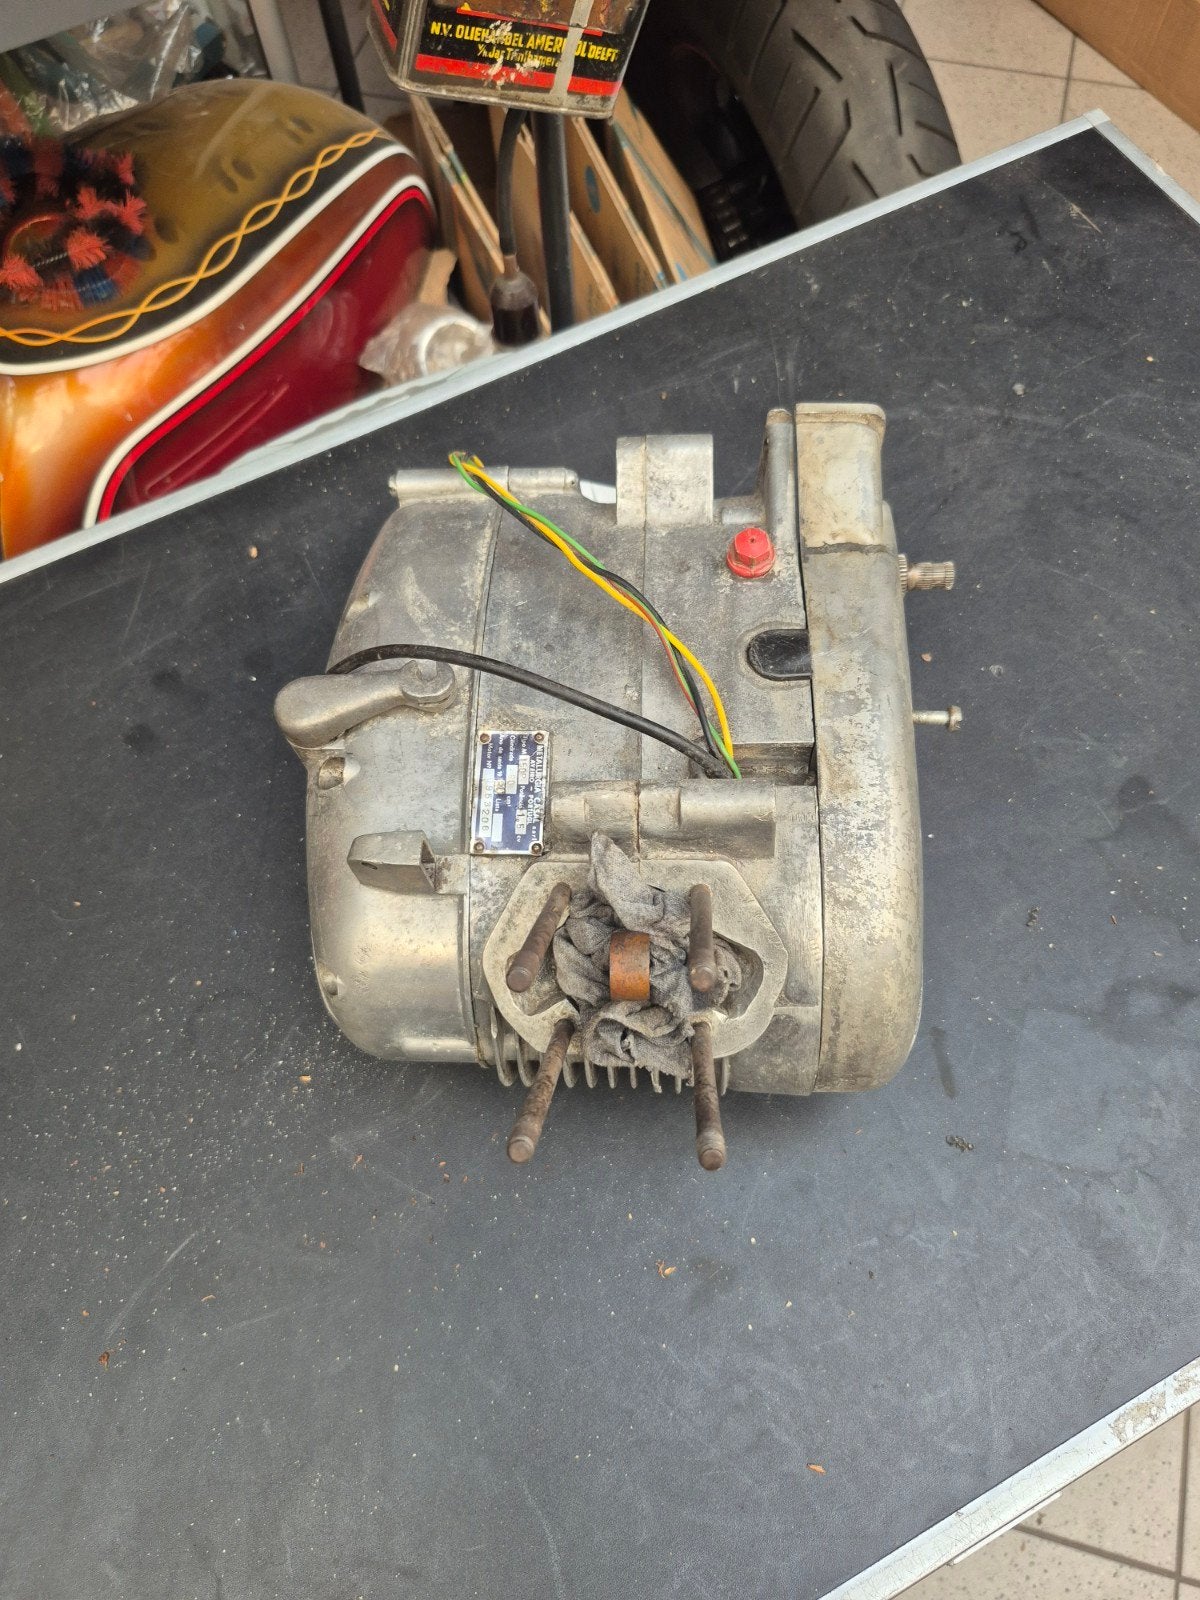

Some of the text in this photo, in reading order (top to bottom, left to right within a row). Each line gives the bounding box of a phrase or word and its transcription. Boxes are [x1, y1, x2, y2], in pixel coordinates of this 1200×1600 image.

[430, 21, 452, 37] N.V.
[587, 44, 618, 62] DELFT
[533, 797, 541, 823] CASAL
